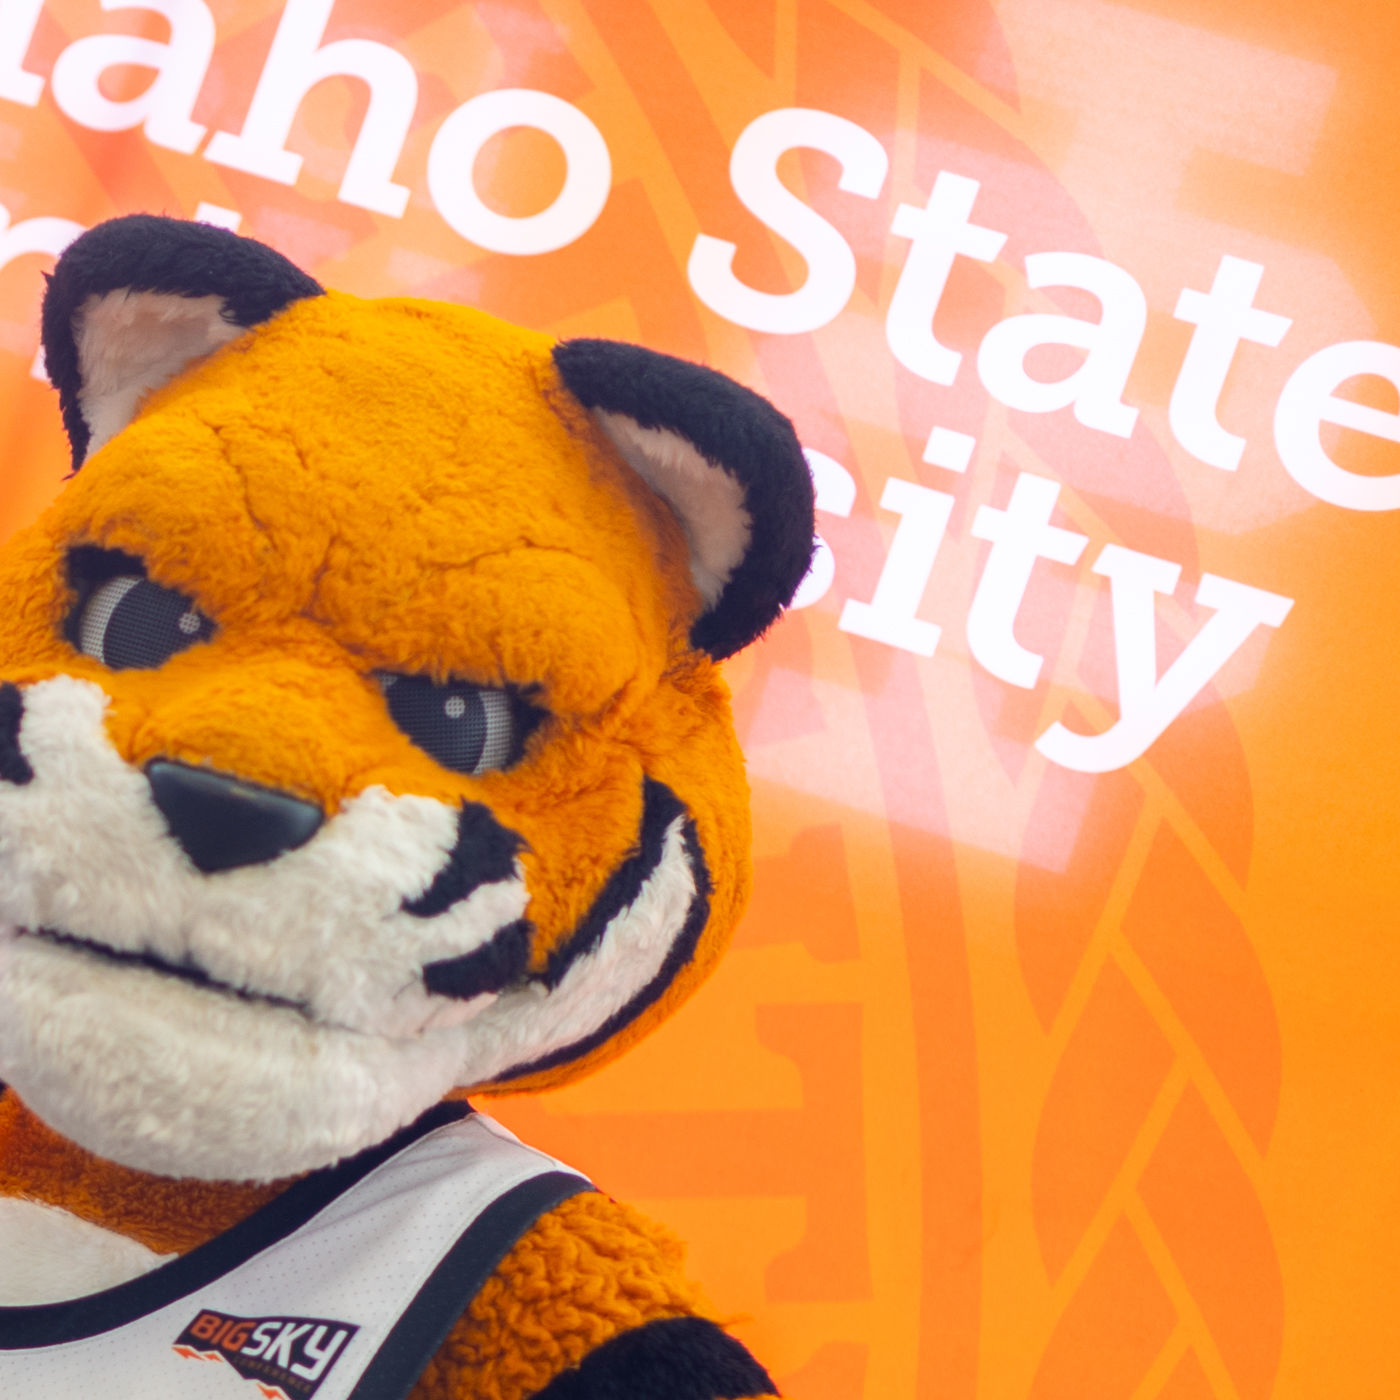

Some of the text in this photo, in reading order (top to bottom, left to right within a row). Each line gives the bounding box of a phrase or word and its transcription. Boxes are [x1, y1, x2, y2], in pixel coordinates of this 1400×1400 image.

[686, 106, 1400, 513] State
[189, 1313, 349, 1382] BIG SKY
